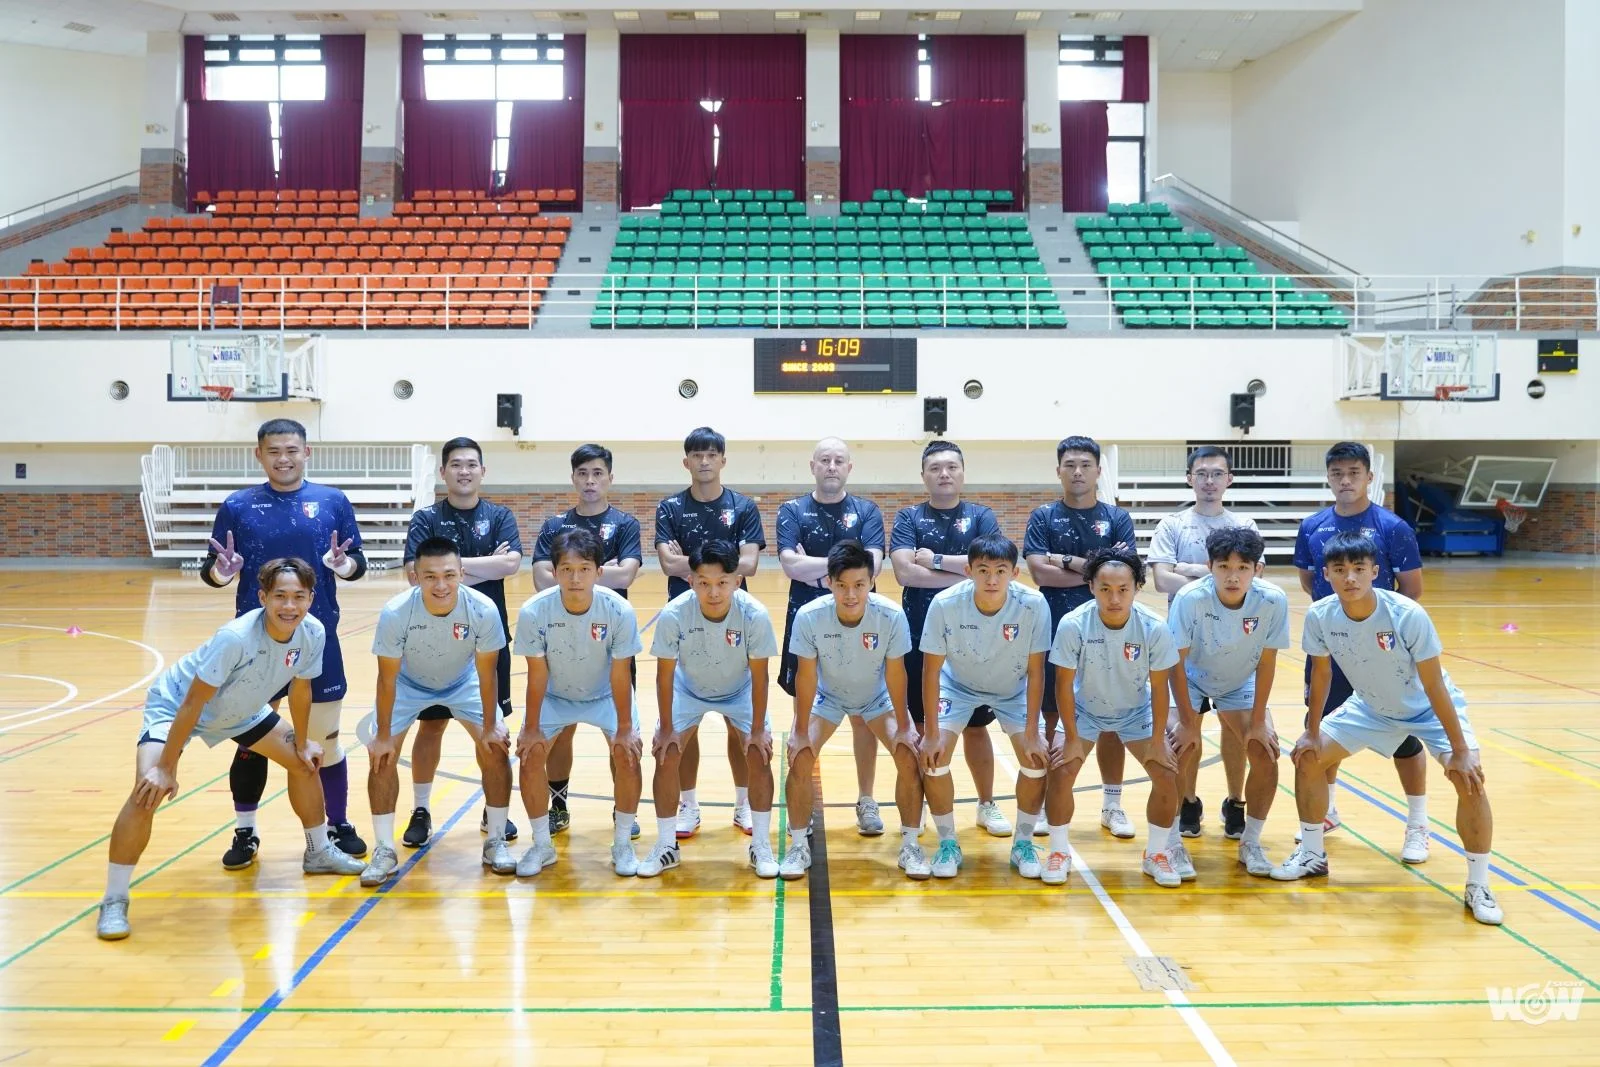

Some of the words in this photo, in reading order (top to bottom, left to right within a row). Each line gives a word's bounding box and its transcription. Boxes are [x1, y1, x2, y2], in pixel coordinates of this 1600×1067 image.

[818, 338, 860, 356] 16:09
[781, 362, 809, 372] SINCE
[811, 362, 835, 372] 2003
[323, 684, 341, 694] ENTES
